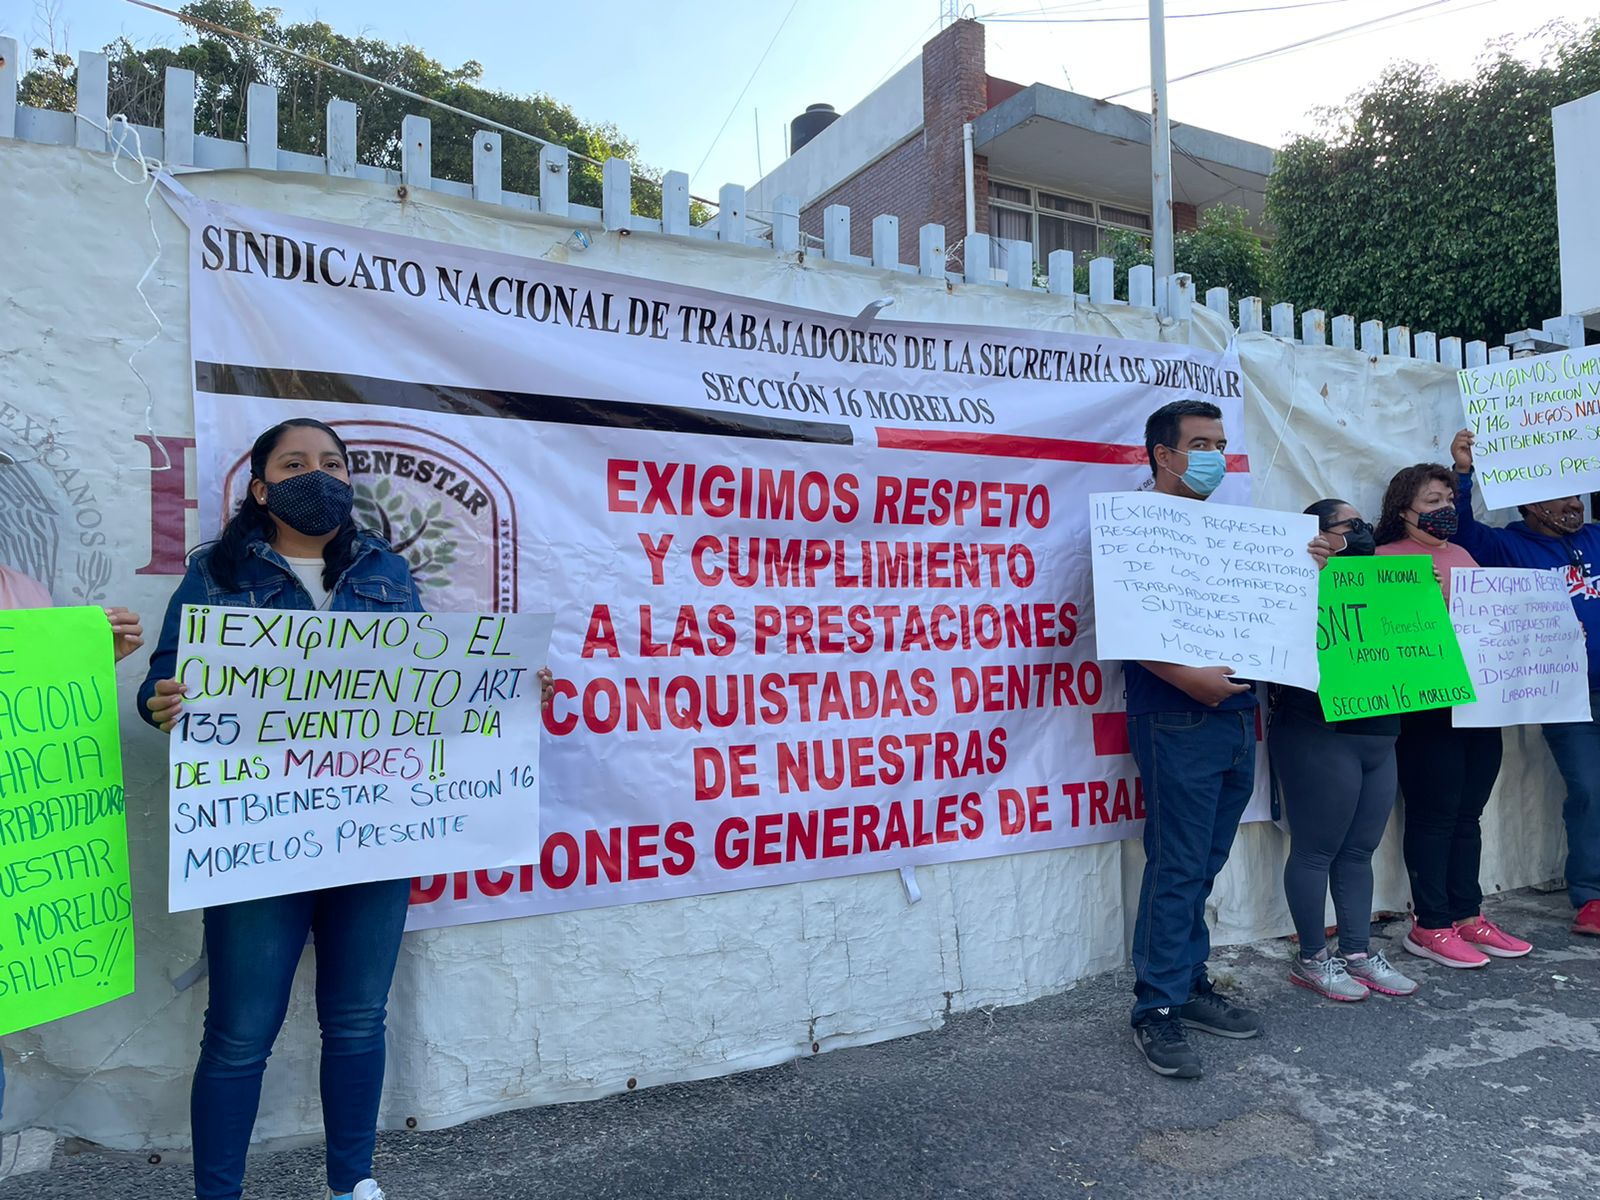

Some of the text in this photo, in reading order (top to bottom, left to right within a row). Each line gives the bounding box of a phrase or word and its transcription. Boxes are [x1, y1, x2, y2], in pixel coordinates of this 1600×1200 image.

[201, 225, 1242, 399] SINDICATO NACIONAL DE TRABAJADORES DE LA SECRETARÍA DE BIENESTAR
[702, 370, 995, 425] SECCIÓN 16 MORELOS
[1530, 382, 1582, 406] FRACCION
[1471, 416, 1481, 435] Y
[1486, 414, 1510, 434] 146
[1520, 406, 1573, 428] JUEGOS
[606, 458, 1050, 530] EXIGIMOS RESPETO
[1482, 463, 1552, 487] MORELOS
[1095, 525, 1294, 558] RESGUARDOS DE EQUIPO
[1201, 515, 1287, 537] REGRESEN
[637, 532, 1036, 589] Y CUMPLIMIENTO
[1098, 543, 1129, 556] DE
[1220, 558, 1231, 573] Y
[1234, 559, 1315, 580] ESCRITORIOS
[1123, 560, 1156, 573] DE
[1171, 565, 1200, 582] LOS
[1333, 569, 1421, 590] PARO NACIONAL
[1114, 579, 1299, 611] TRABAJADORES DEL
[1453, 597, 1465, 618] A
[1469, 605, 1489, 617] LA
[1491, 603, 1520, 617] BASE
[466, 615, 519, 658] EL
[580, 602, 1078, 659] A LAS PRESTACIONES
[1233, 627, 1251, 640] 16
[1316, 603, 1438, 651] SNT Bienestar
[1453, 623, 1482, 635] DEL
[1498, 651, 1515, 662] NO
[1522, 647, 1531, 657] A
[178, 657, 527, 709] CUMPLIMIENTO ART.
[542, 662, 1101, 737] CONQUISTADAS DENTRO
[1333, 683, 1471, 717] SECCION 16 MORELOS
[177, 704, 502, 746] 135 EVENTO DEL DÍA
[175, 761, 211, 790] DE
[220, 756, 271, 782] LAS
[693, 727, 1008, 803] DE NUESTRAS
[174, 764, 535, 835] SNTBIENESTAR SECCION 16
[714, 790, 985, 871] GENERALES
[998, 786, 1052, 838] DE
[183, 814, 469, 883] MORELOS PRESENTE
[14, 882, 132, 946] MORELOS
